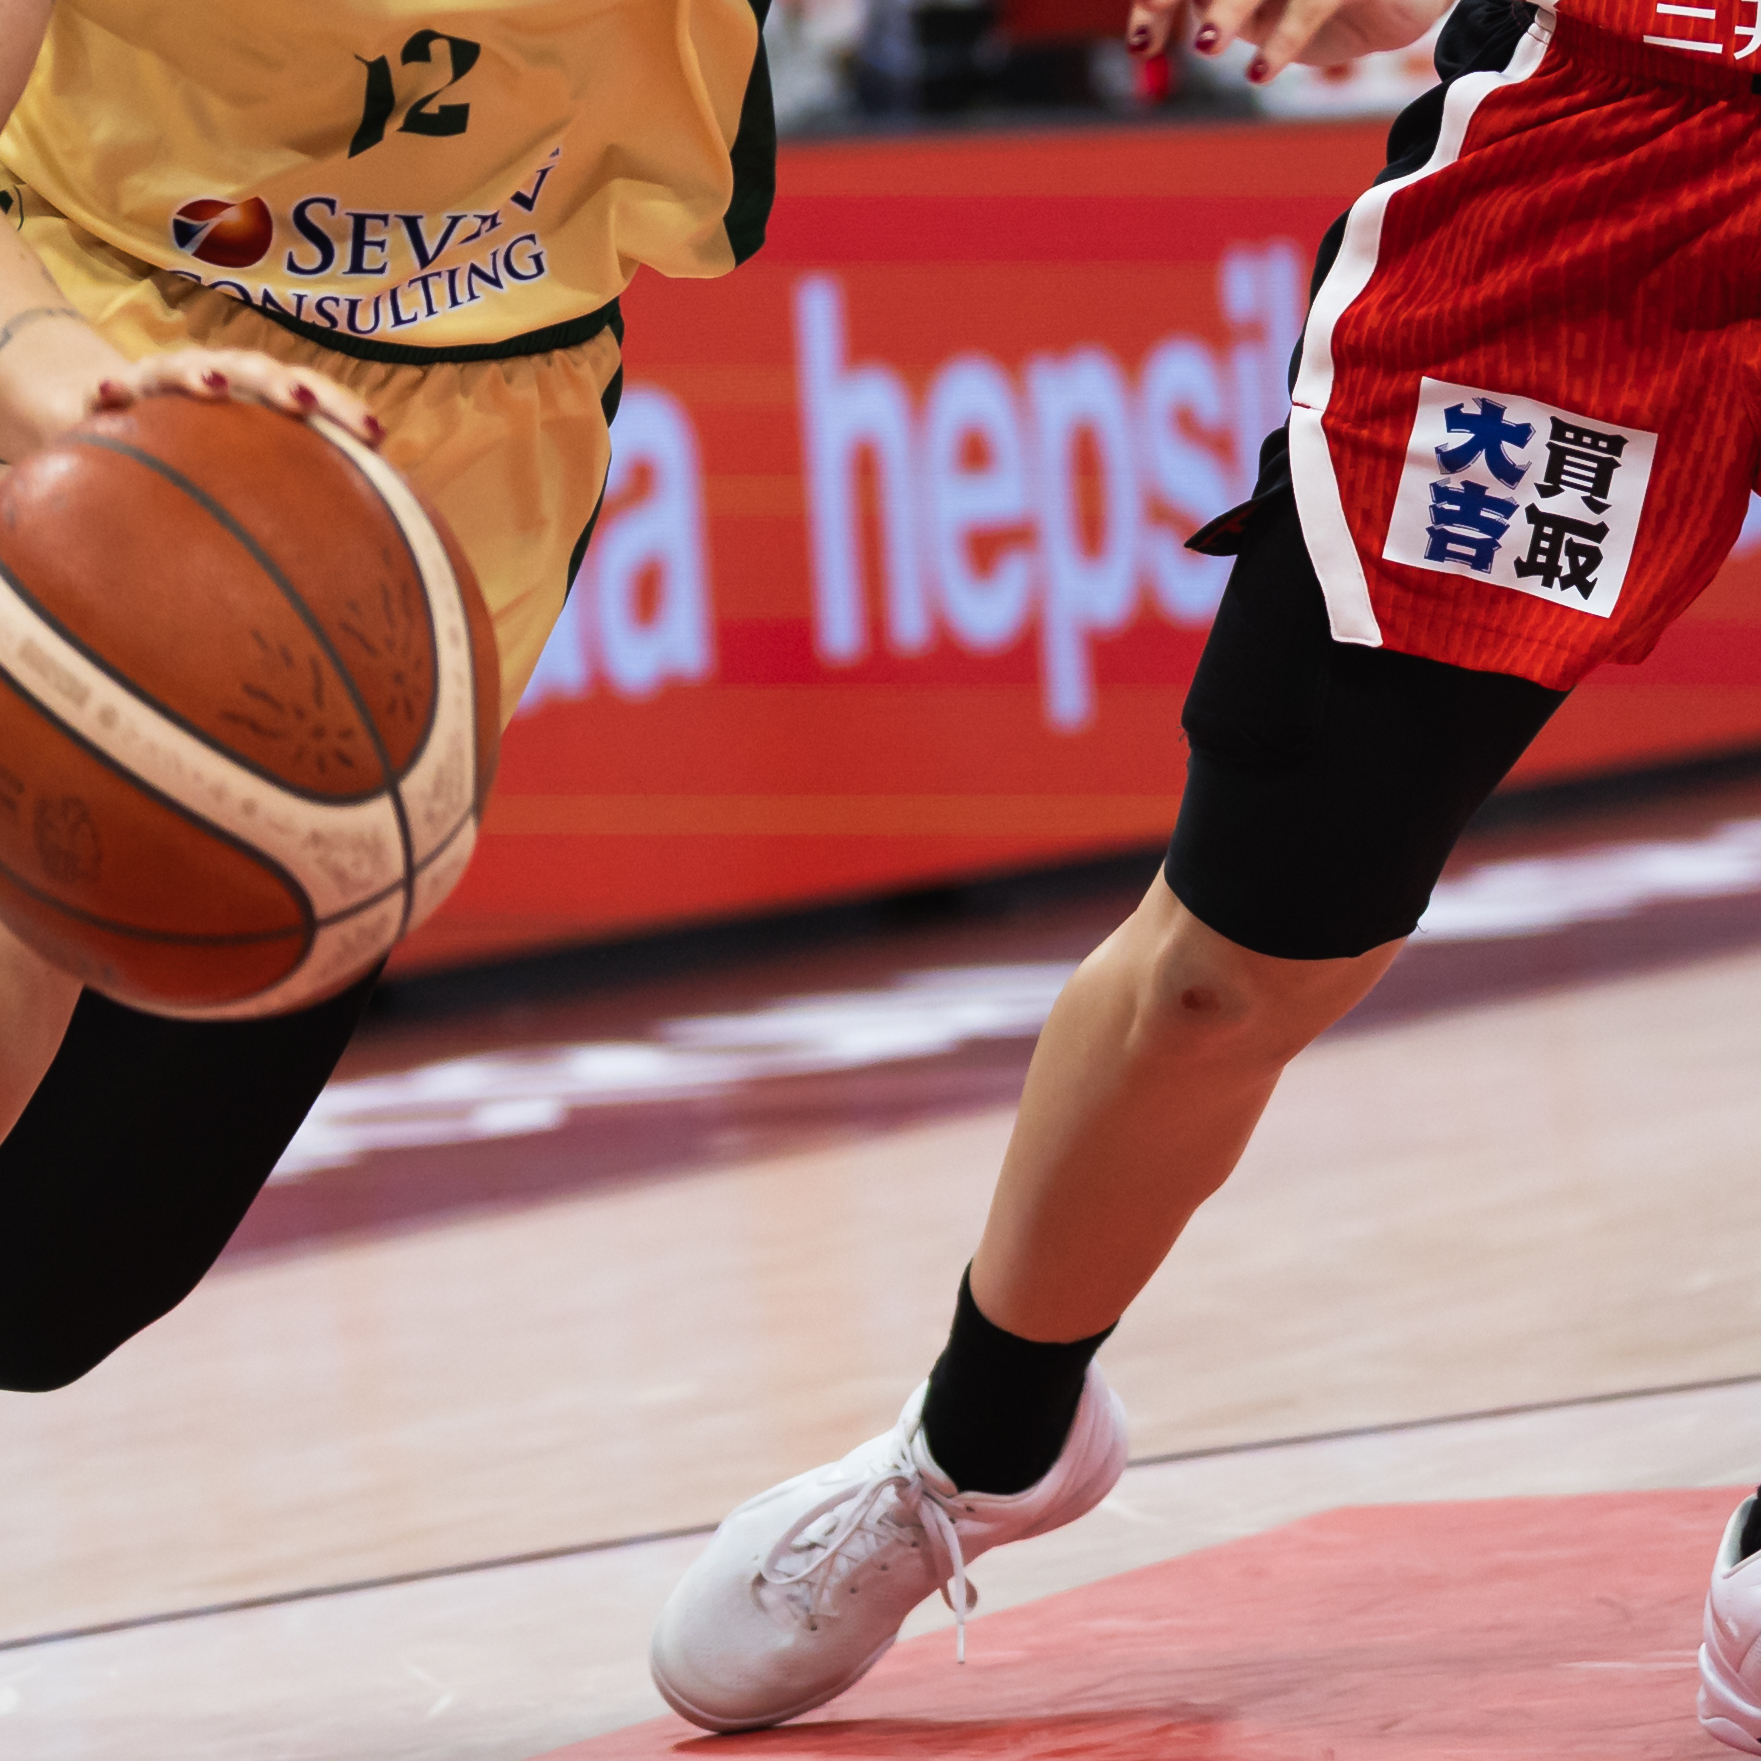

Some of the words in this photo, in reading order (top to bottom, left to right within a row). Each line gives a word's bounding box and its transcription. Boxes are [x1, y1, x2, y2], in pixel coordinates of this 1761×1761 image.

[348, 29, 481, 158] 12
[286, 147, 560, 275] SEV
[168, 234, 544, 334] NSULTING
[1424, 397, 1536, 574] 大吉
[1514, 416, 1629, 600] 買取
